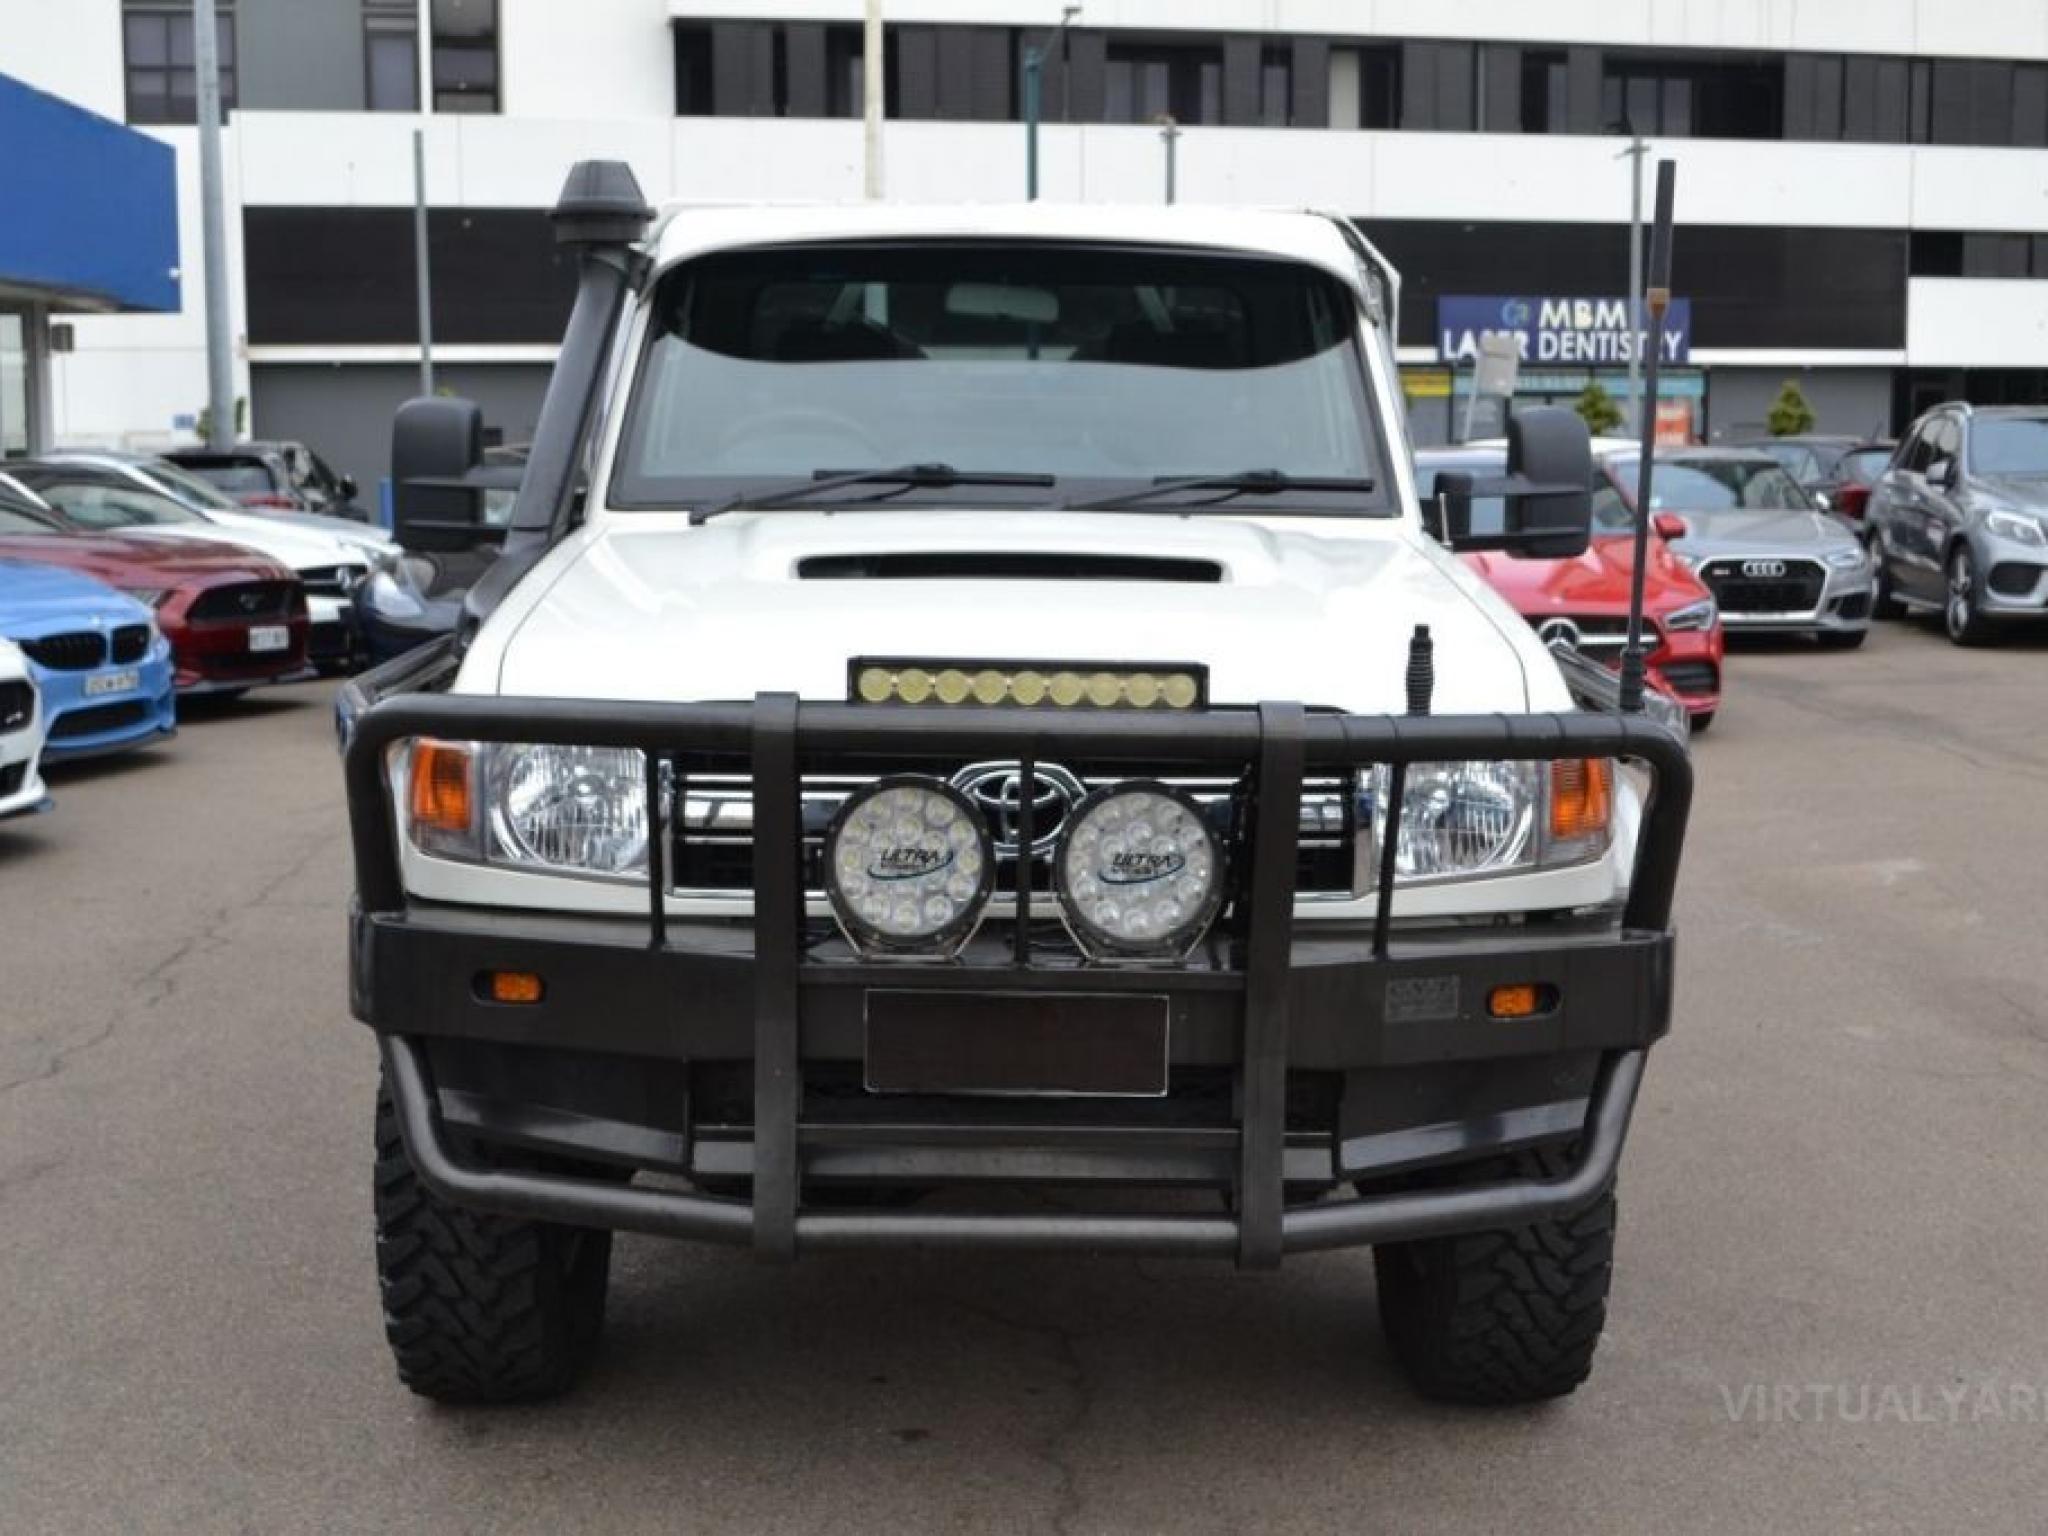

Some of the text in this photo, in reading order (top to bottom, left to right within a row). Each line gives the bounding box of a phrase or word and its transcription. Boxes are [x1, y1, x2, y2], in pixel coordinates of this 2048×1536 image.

[1538, 298, 1627, 329] MBM
[1442, 329, 1682, 361] LAR DENTISTY
[881, 848, 939, 864] ULTRA
[1112, 853, 1170, 867] ULTRA
